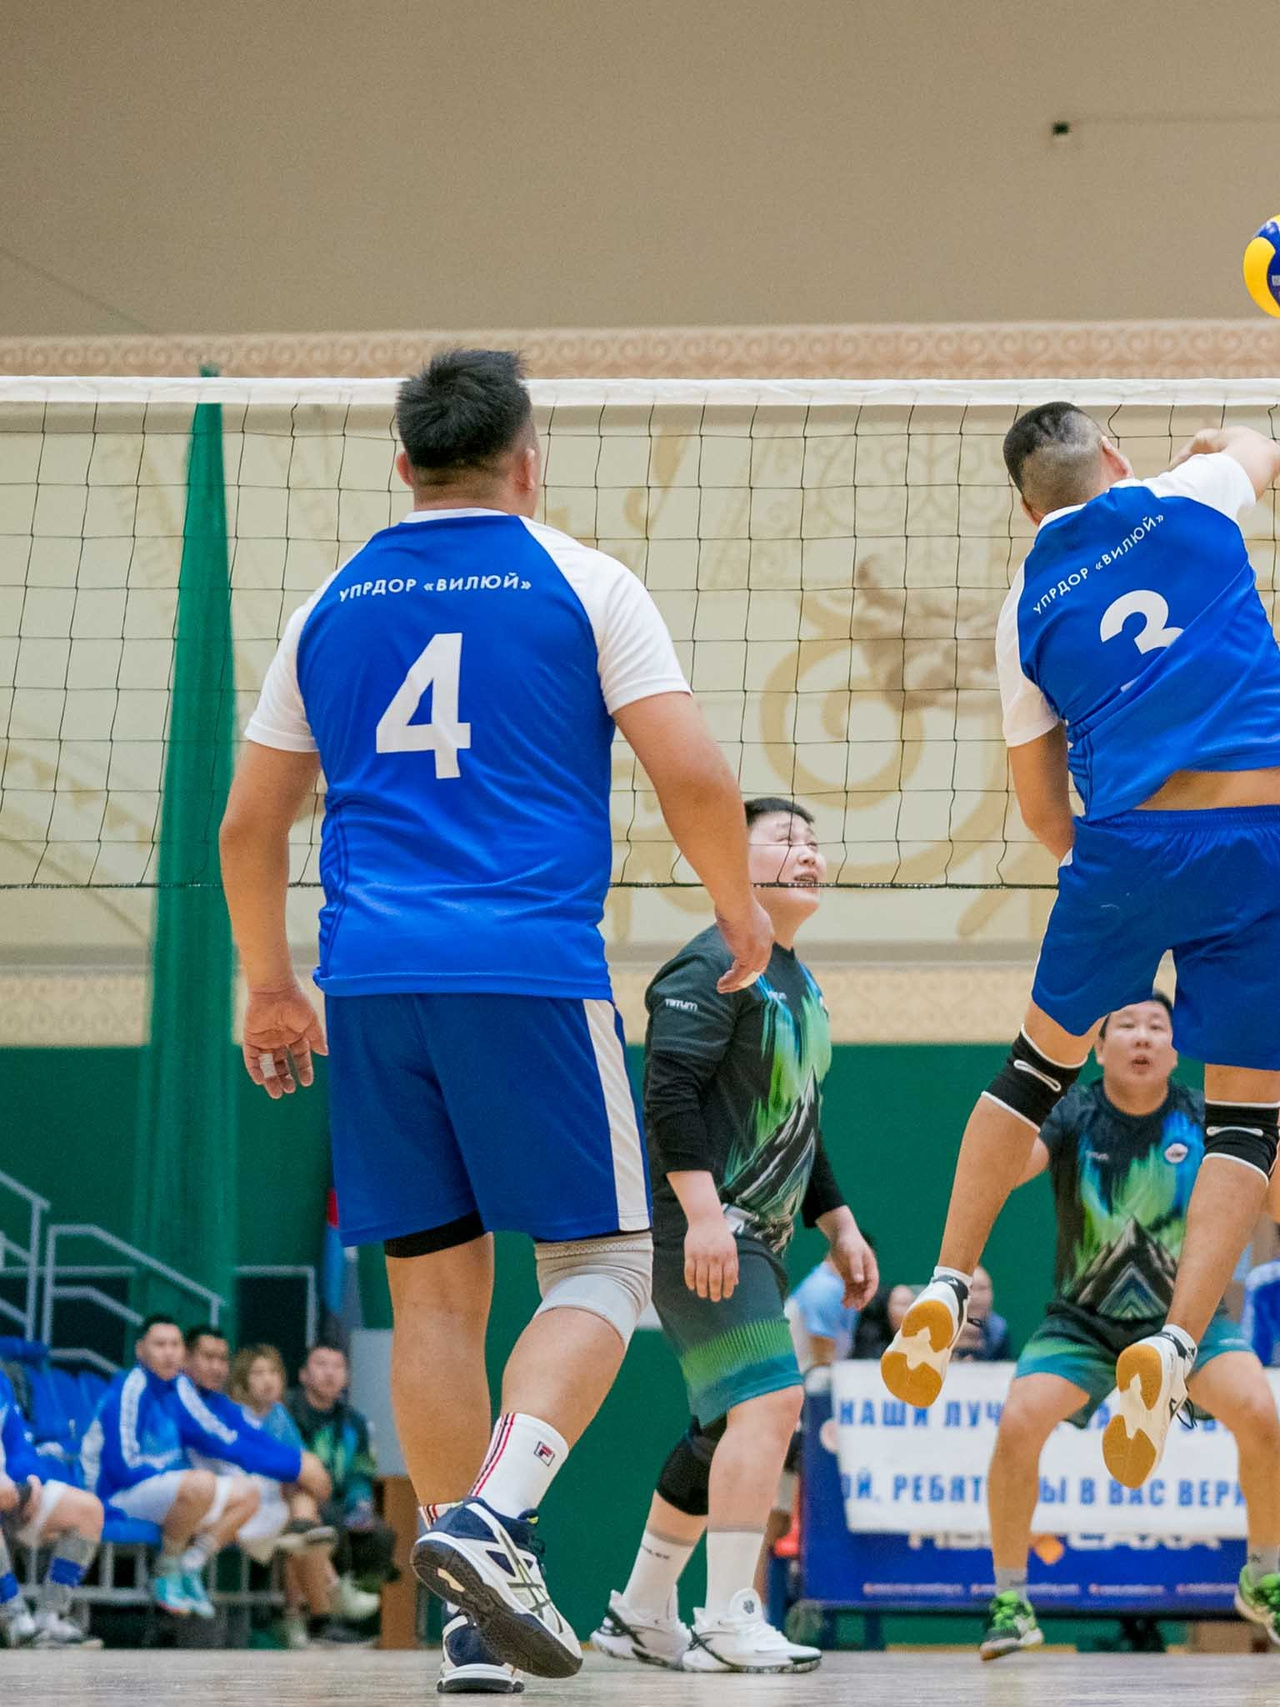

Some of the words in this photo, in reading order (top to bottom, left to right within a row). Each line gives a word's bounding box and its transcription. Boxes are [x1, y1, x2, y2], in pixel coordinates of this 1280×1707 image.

[339, 577, 417, 603] УПРДОР
[423, 571, 532, 593] «ВИЛЮЙ»
[1033, 567, 1089, 615] УПРДОР
[1094, 513, 1165, 571] «ВИЛЮЙ»
[1100, 589, 1185, 668] 3
[376, 632, 472, 779] 4
[839, 1400, 929, 1427] НАШИ
[892, 1474, 984, 1502] РЕБЯТ
[1080, 1478, 1096, 1505] В
